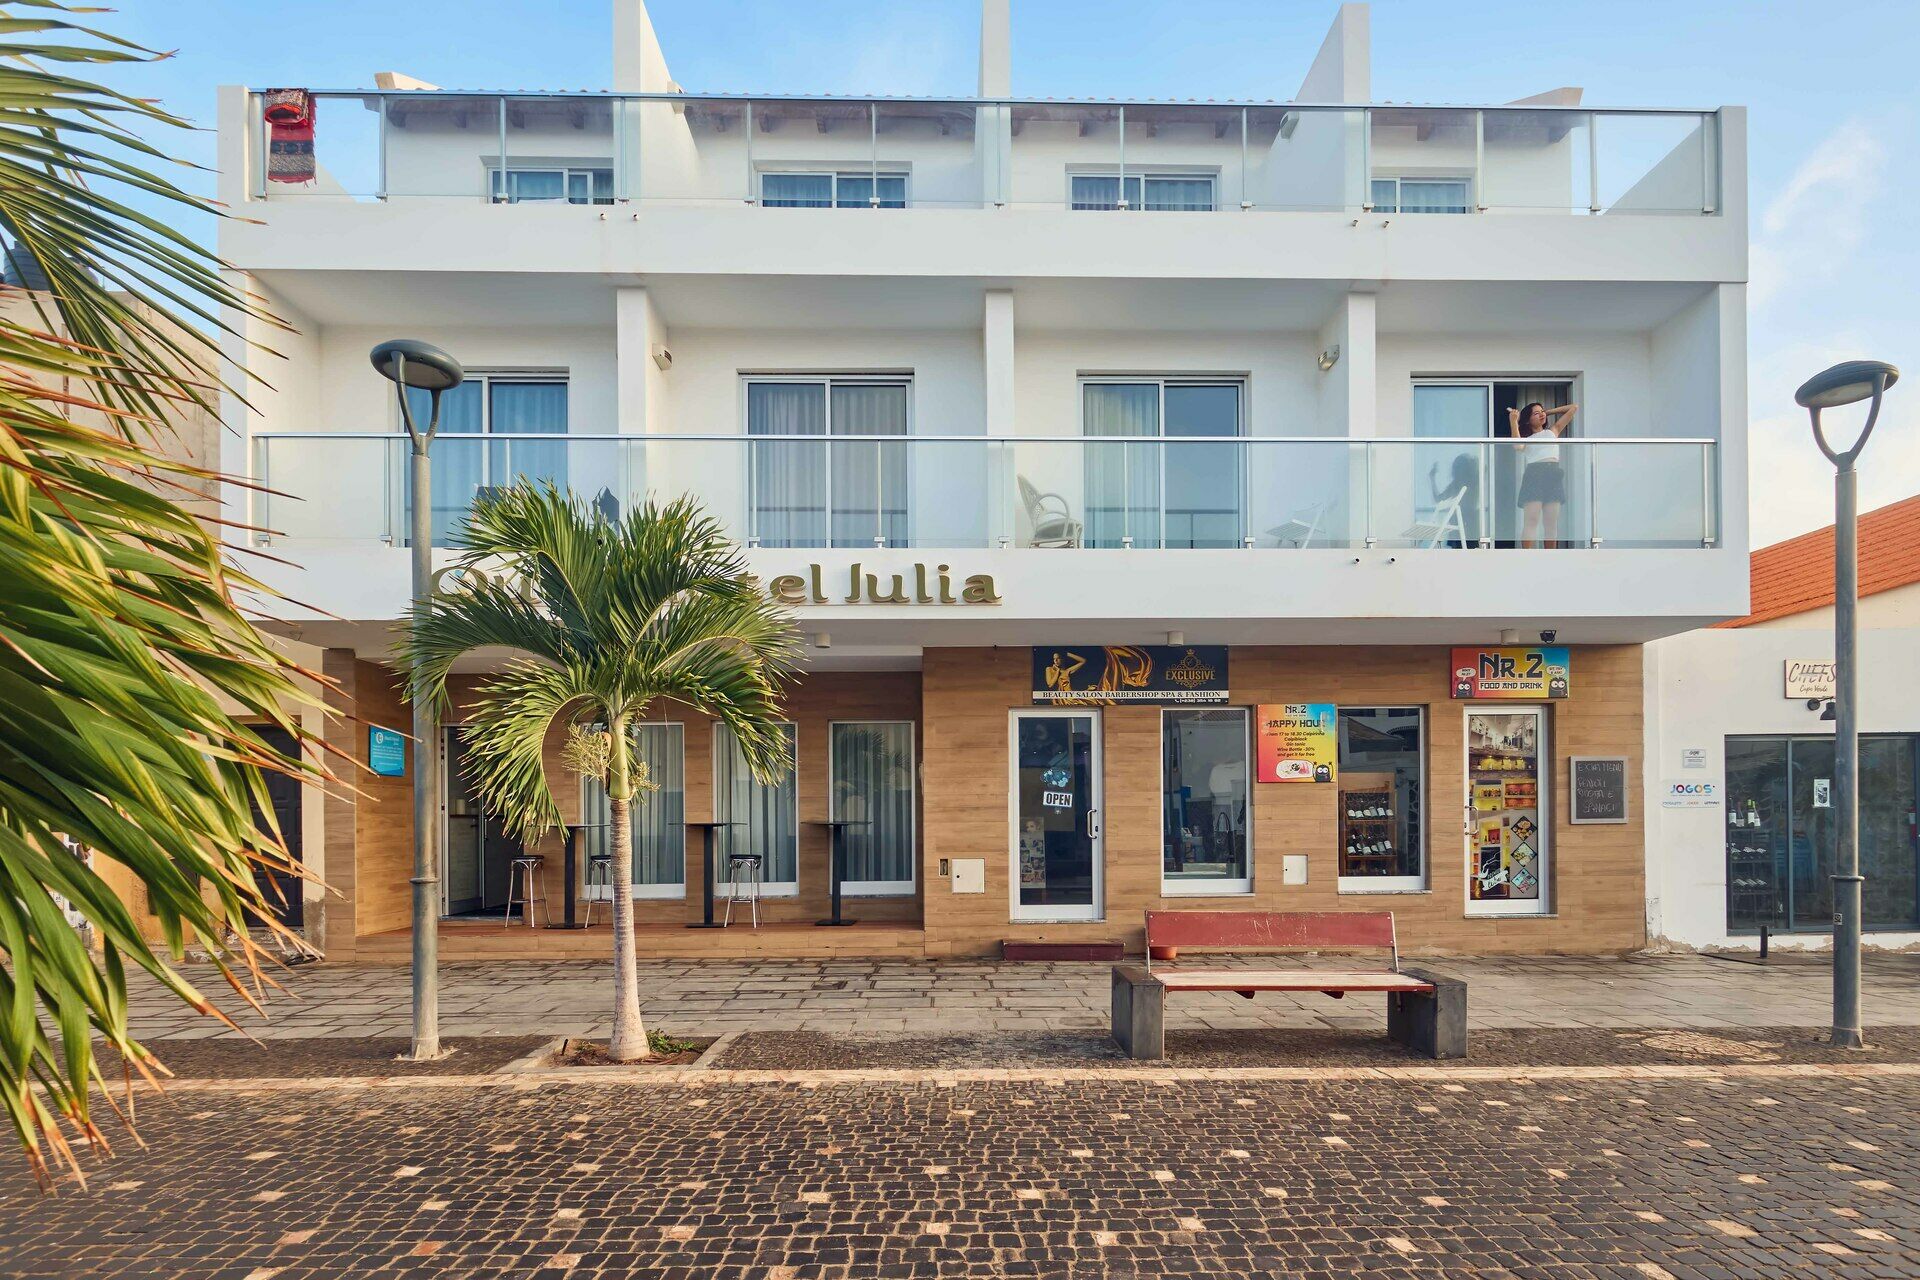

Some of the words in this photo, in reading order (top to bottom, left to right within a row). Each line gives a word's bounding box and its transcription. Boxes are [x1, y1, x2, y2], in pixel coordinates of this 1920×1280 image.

[845, 563, 1002, 604] Julia
[1165, 669, 1216, 681] EXCLUSIVE
[1480, 682, 1499, 690] FOOD
[1502, 682, 1518, 690] AND
[1520, 682, 1543, 690] DRINK
[1266, 719, 1297, 728] HAPPY
[1670, 784, 1712, 793] JOGOS
[1046, 792, 1071, 806] OPEN
